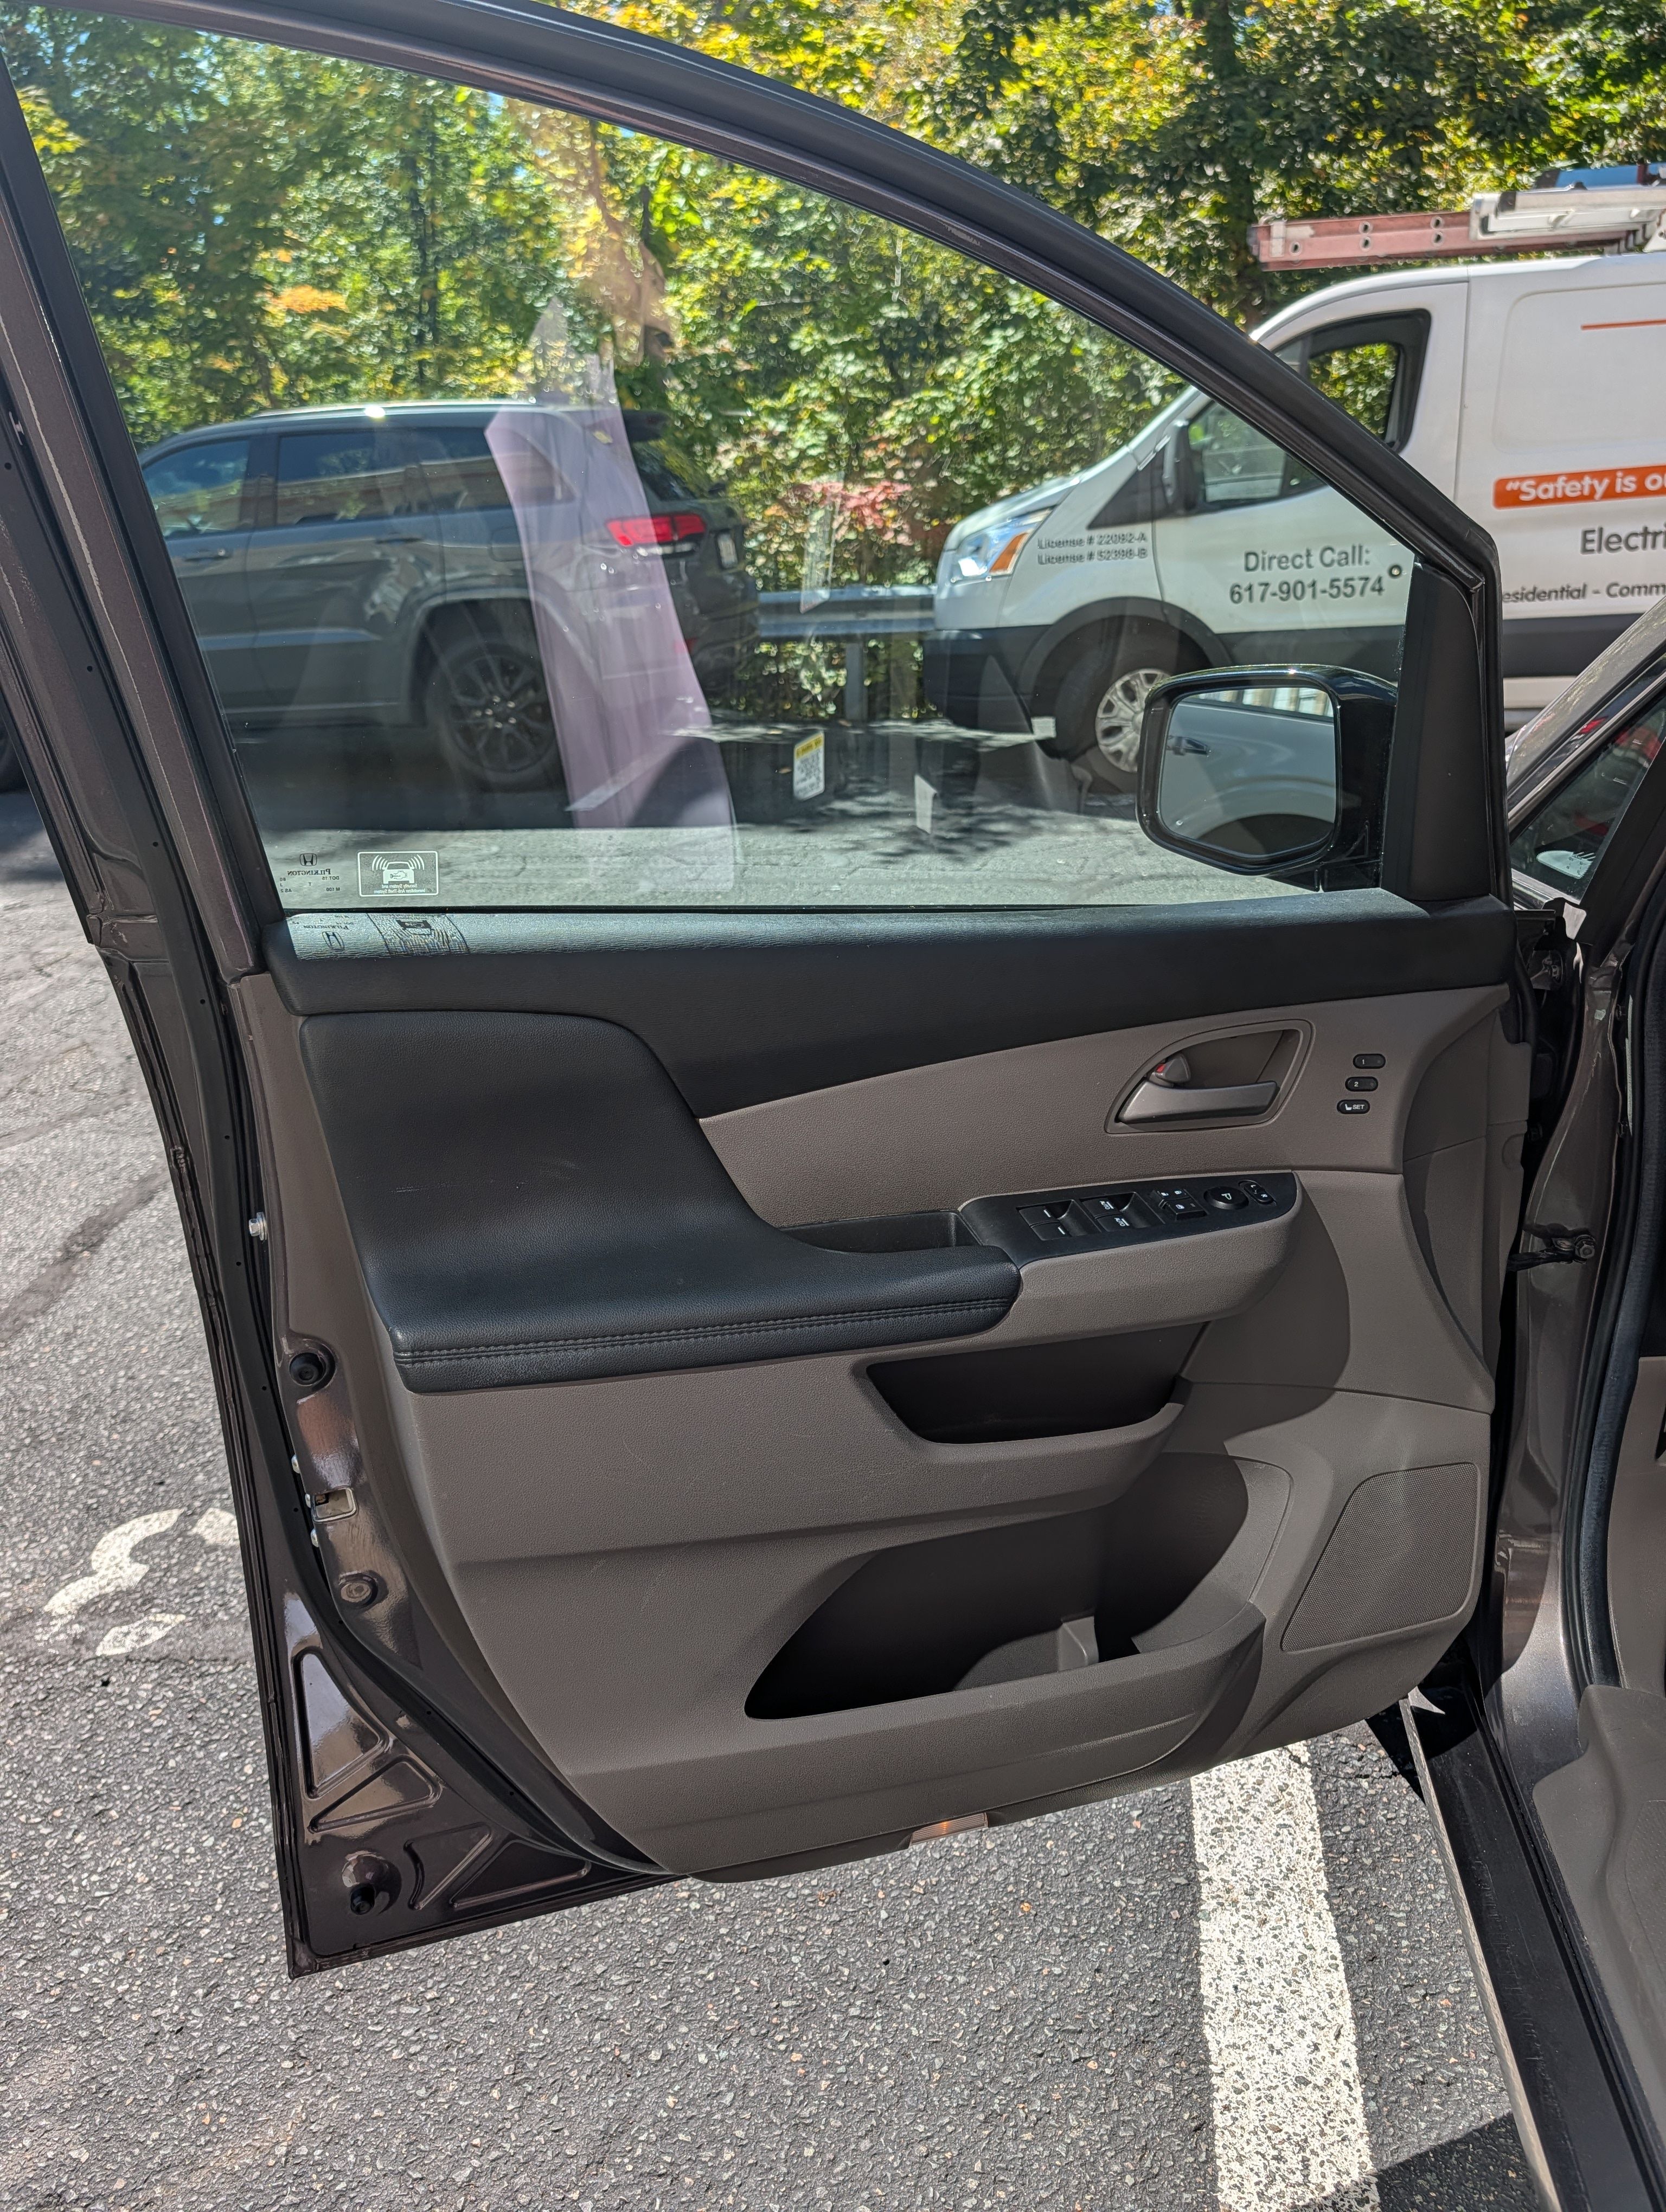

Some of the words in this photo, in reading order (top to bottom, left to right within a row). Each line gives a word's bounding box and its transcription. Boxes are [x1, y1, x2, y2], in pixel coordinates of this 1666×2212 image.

[1614, 471, 1638, 493] is
[1644, 472, 1666, 492] o
[1037, 537, 1085, 550] License
[1086, 534, 1095, 545] #
[1037, 552, 1085, 565] License
[1086, 550, 1095, 562] #
[1244, 546, 1314, 573] Direct
[1319, 543, 1370, 568] Call:
[1229, 575, 1385, 605] 617-901-5574
[1502, 582, 1587, 603] esidential
[1099, 1201, 1110, 1210] AUTO
[1114, 1218, 1126, 1226] AUTO
